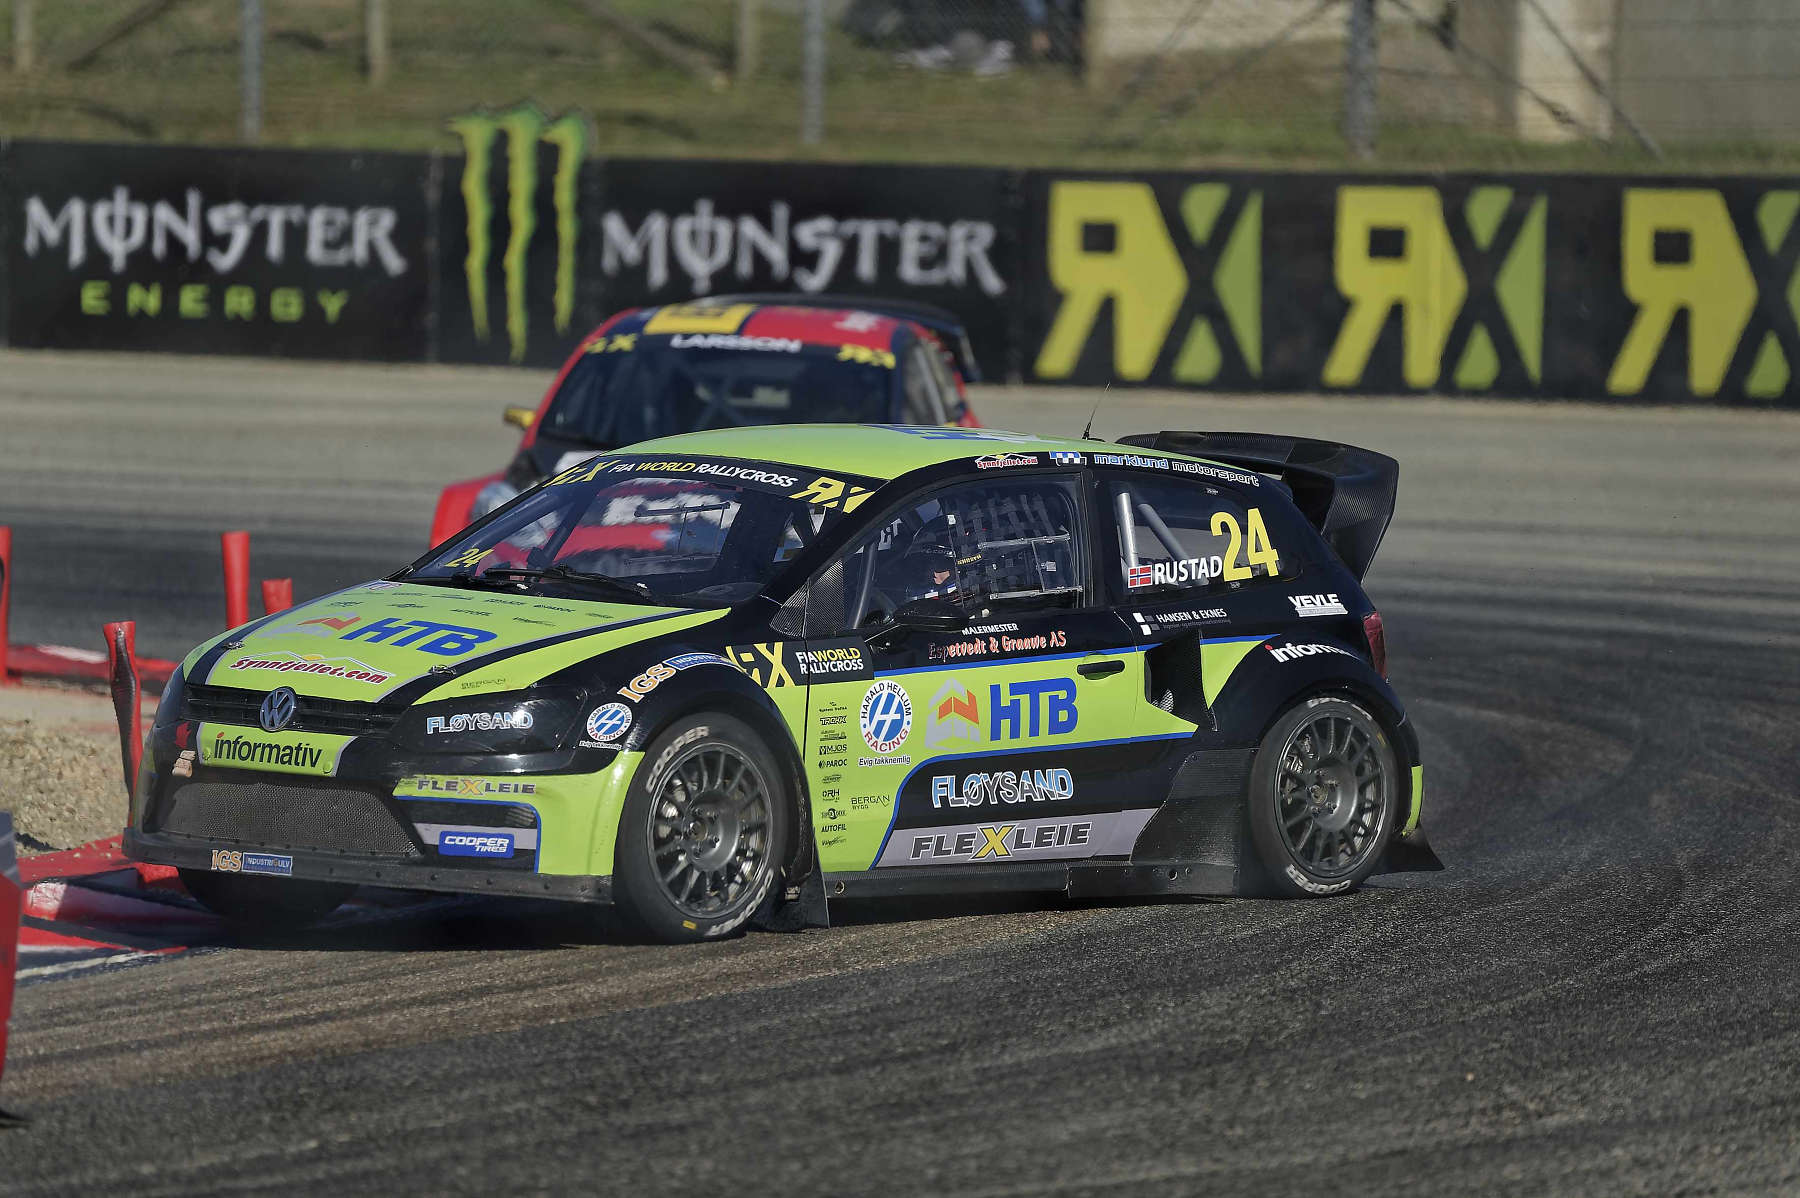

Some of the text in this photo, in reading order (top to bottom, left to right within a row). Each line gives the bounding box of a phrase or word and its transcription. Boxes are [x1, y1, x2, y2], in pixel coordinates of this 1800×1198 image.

[24, 186, 407, 275] MONSTER
[602, 199, 1006, 295] MONSTER
[81, 280, 348, 322] ENERGY
[670, 333, 802, 352] LARSSON
[608, 462, 798, 488] FIA WORLD RALLYCROSS
[1094, 454, 1260, 487] marklund motorsport
[1210, 507, 1280, 582] 24
[444, 548, 494, 568] 24
[1153, 555, 1223, 584] RUSTAD
[1156, 608, 1228, 622] HANSEN & EKNES
[340, 617, 499, 657] HTB
[961, 623, 1019, 636] MALERMESTER
[989, 636, 1000, 653] &
[1049, 630, 1067, 648] AS
[800, 658, 864, 675] RALLYCROSS
[616, 663, 677, 703] IGS
[861, 682, 912, 719] HARALD HELLUM
[989, 677, 1079, 742] HTB
[426, 711, 534, 735] FLØYSAND
[213, 732, 323, 768] informativ
[864, 728, 909, 752] RACING
[646, 726, 710, 793] COOPER
[826, 759, 847, 767] PAROC
[859, 754, 911, 767] Evig takknemlig
[851, 795, 890, 807] BERGAN
[932, 768, 1073, 808] FLØYSAND
[445, 836, 509, 847] COOPER
[475, 845, 507, 853] TIRES
[911, 822, 1093, 860] FLEXLEIE
[212, 849, 242, 871] IGS
